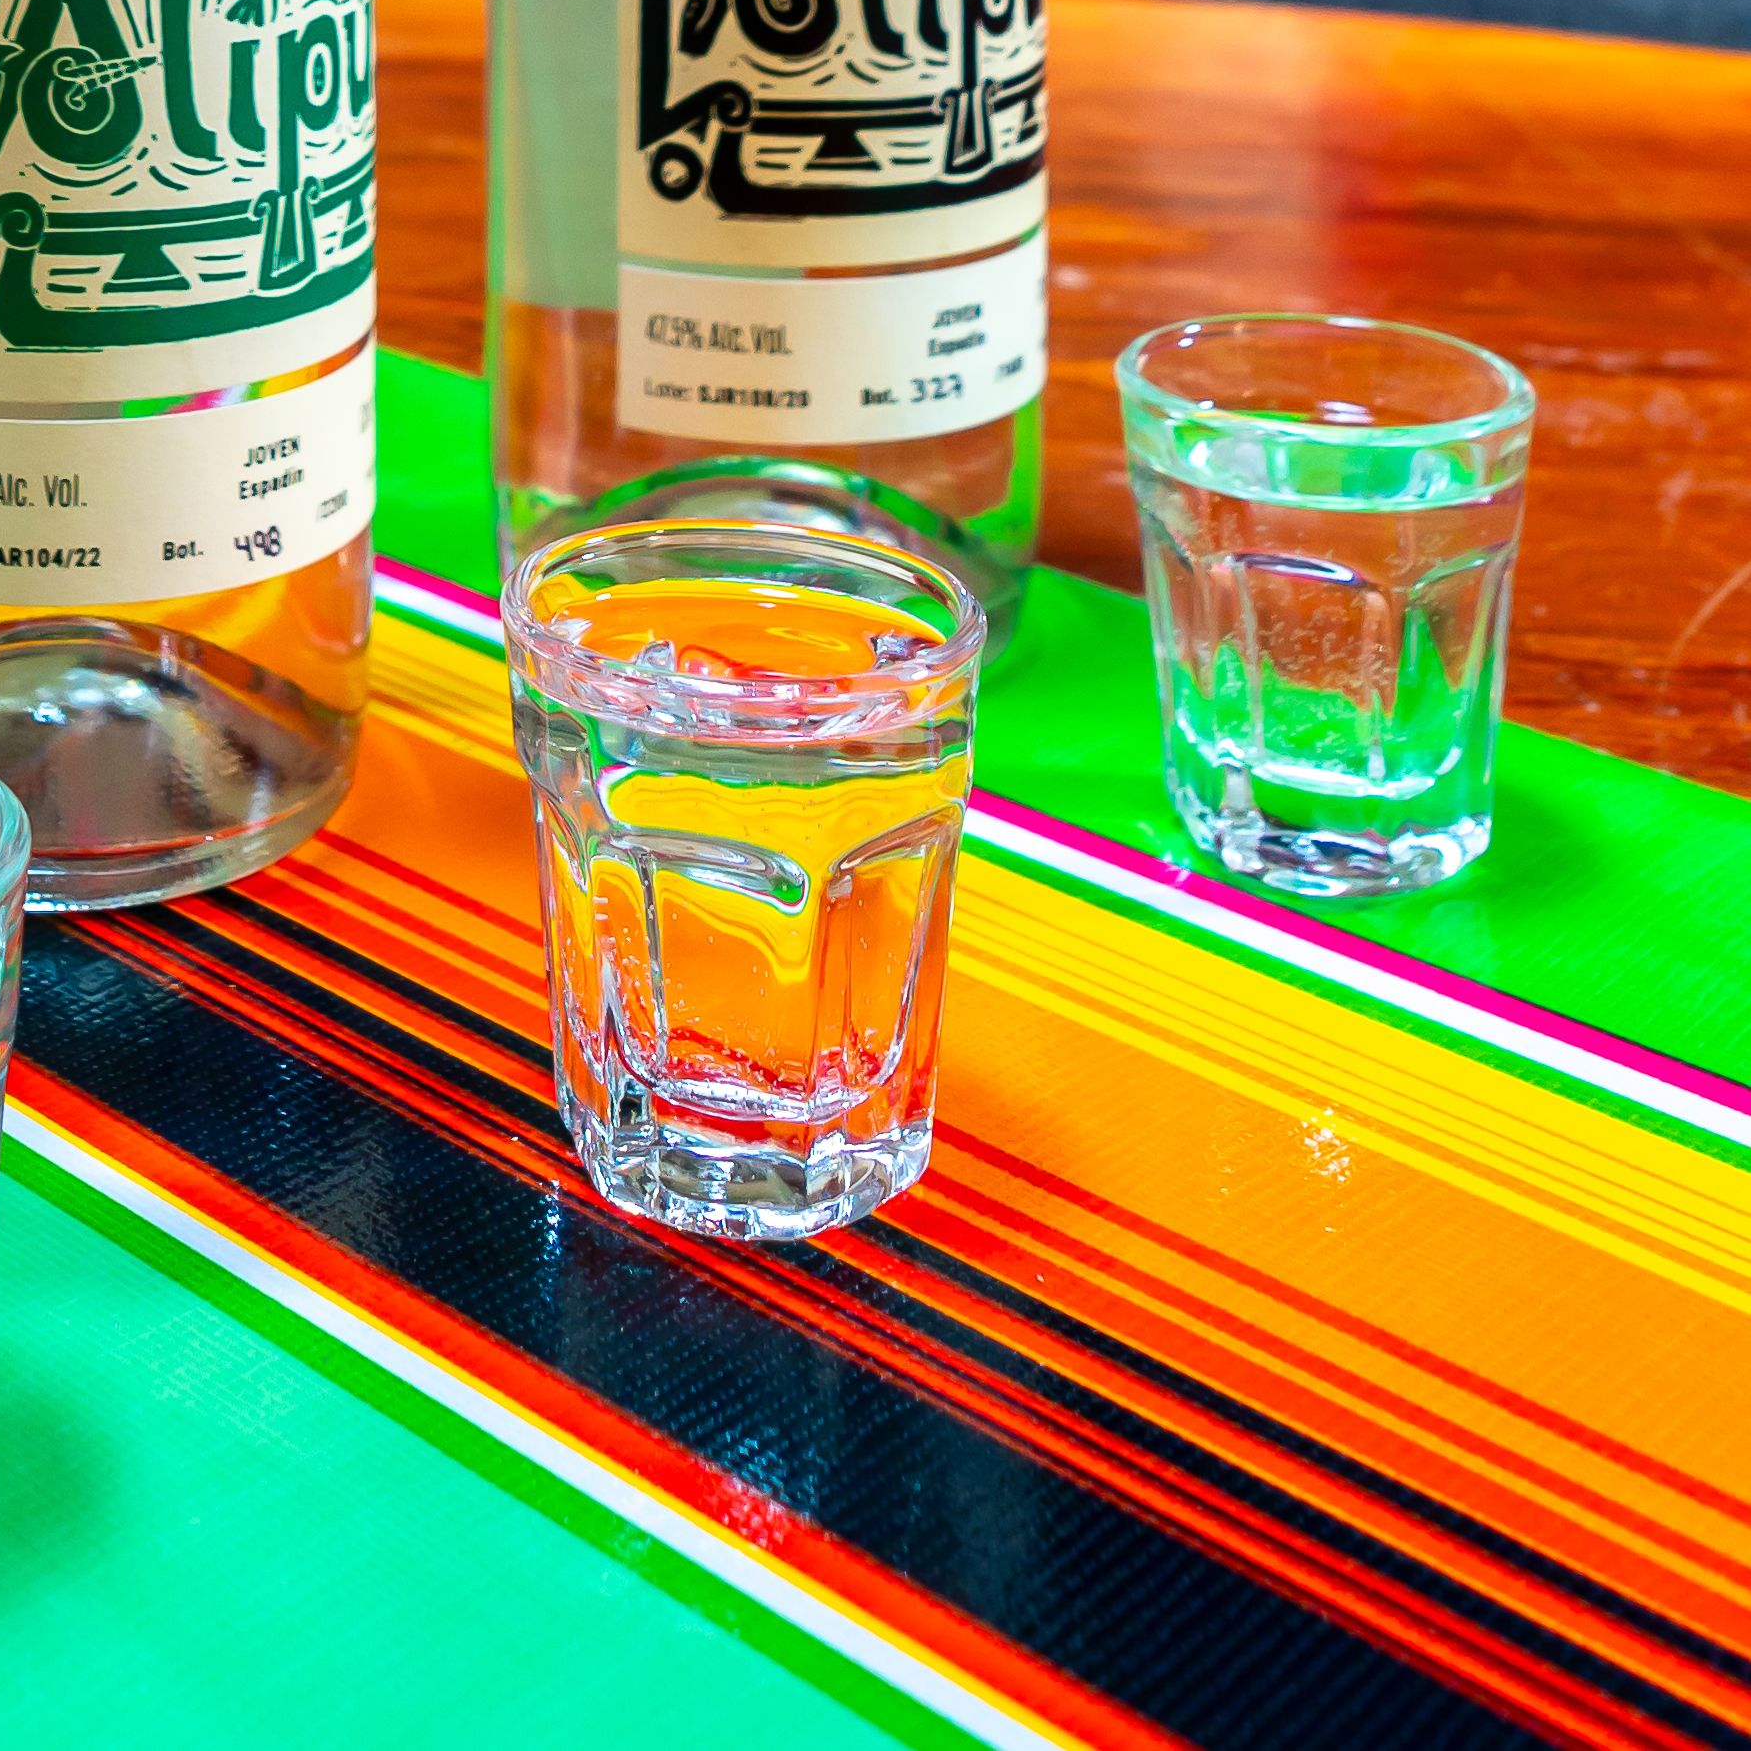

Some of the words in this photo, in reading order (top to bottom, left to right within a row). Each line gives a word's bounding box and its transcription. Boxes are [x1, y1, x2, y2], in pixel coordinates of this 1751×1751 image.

[243, 435, 301, 469] JOVEN
[43, 472, 88, 508] Vol.
[162, 539, 205, 562] Bot.
[233, 524, 284, 563] 498
